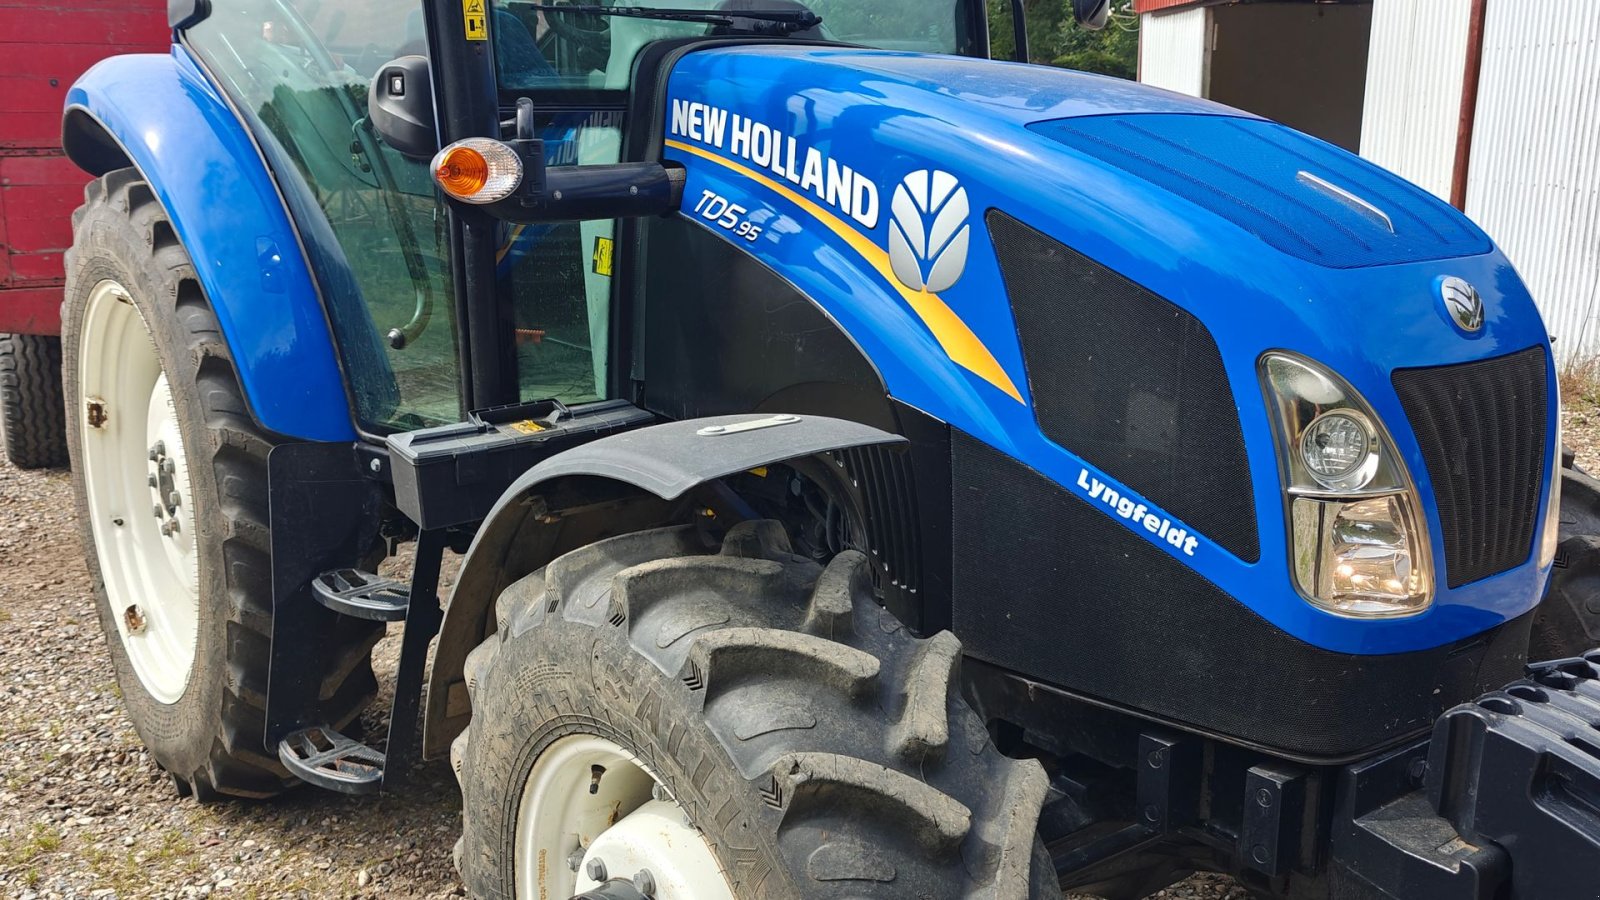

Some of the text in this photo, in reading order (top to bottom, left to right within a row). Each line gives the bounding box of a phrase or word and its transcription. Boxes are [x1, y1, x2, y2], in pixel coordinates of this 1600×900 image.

[672, 99, 727, 148] NEW
[731, 114, 879, 229] HOLLAND
[694, 189, 763, 241] TD5.95
[1077, 468, 1198, 556] Lyngfeldt
